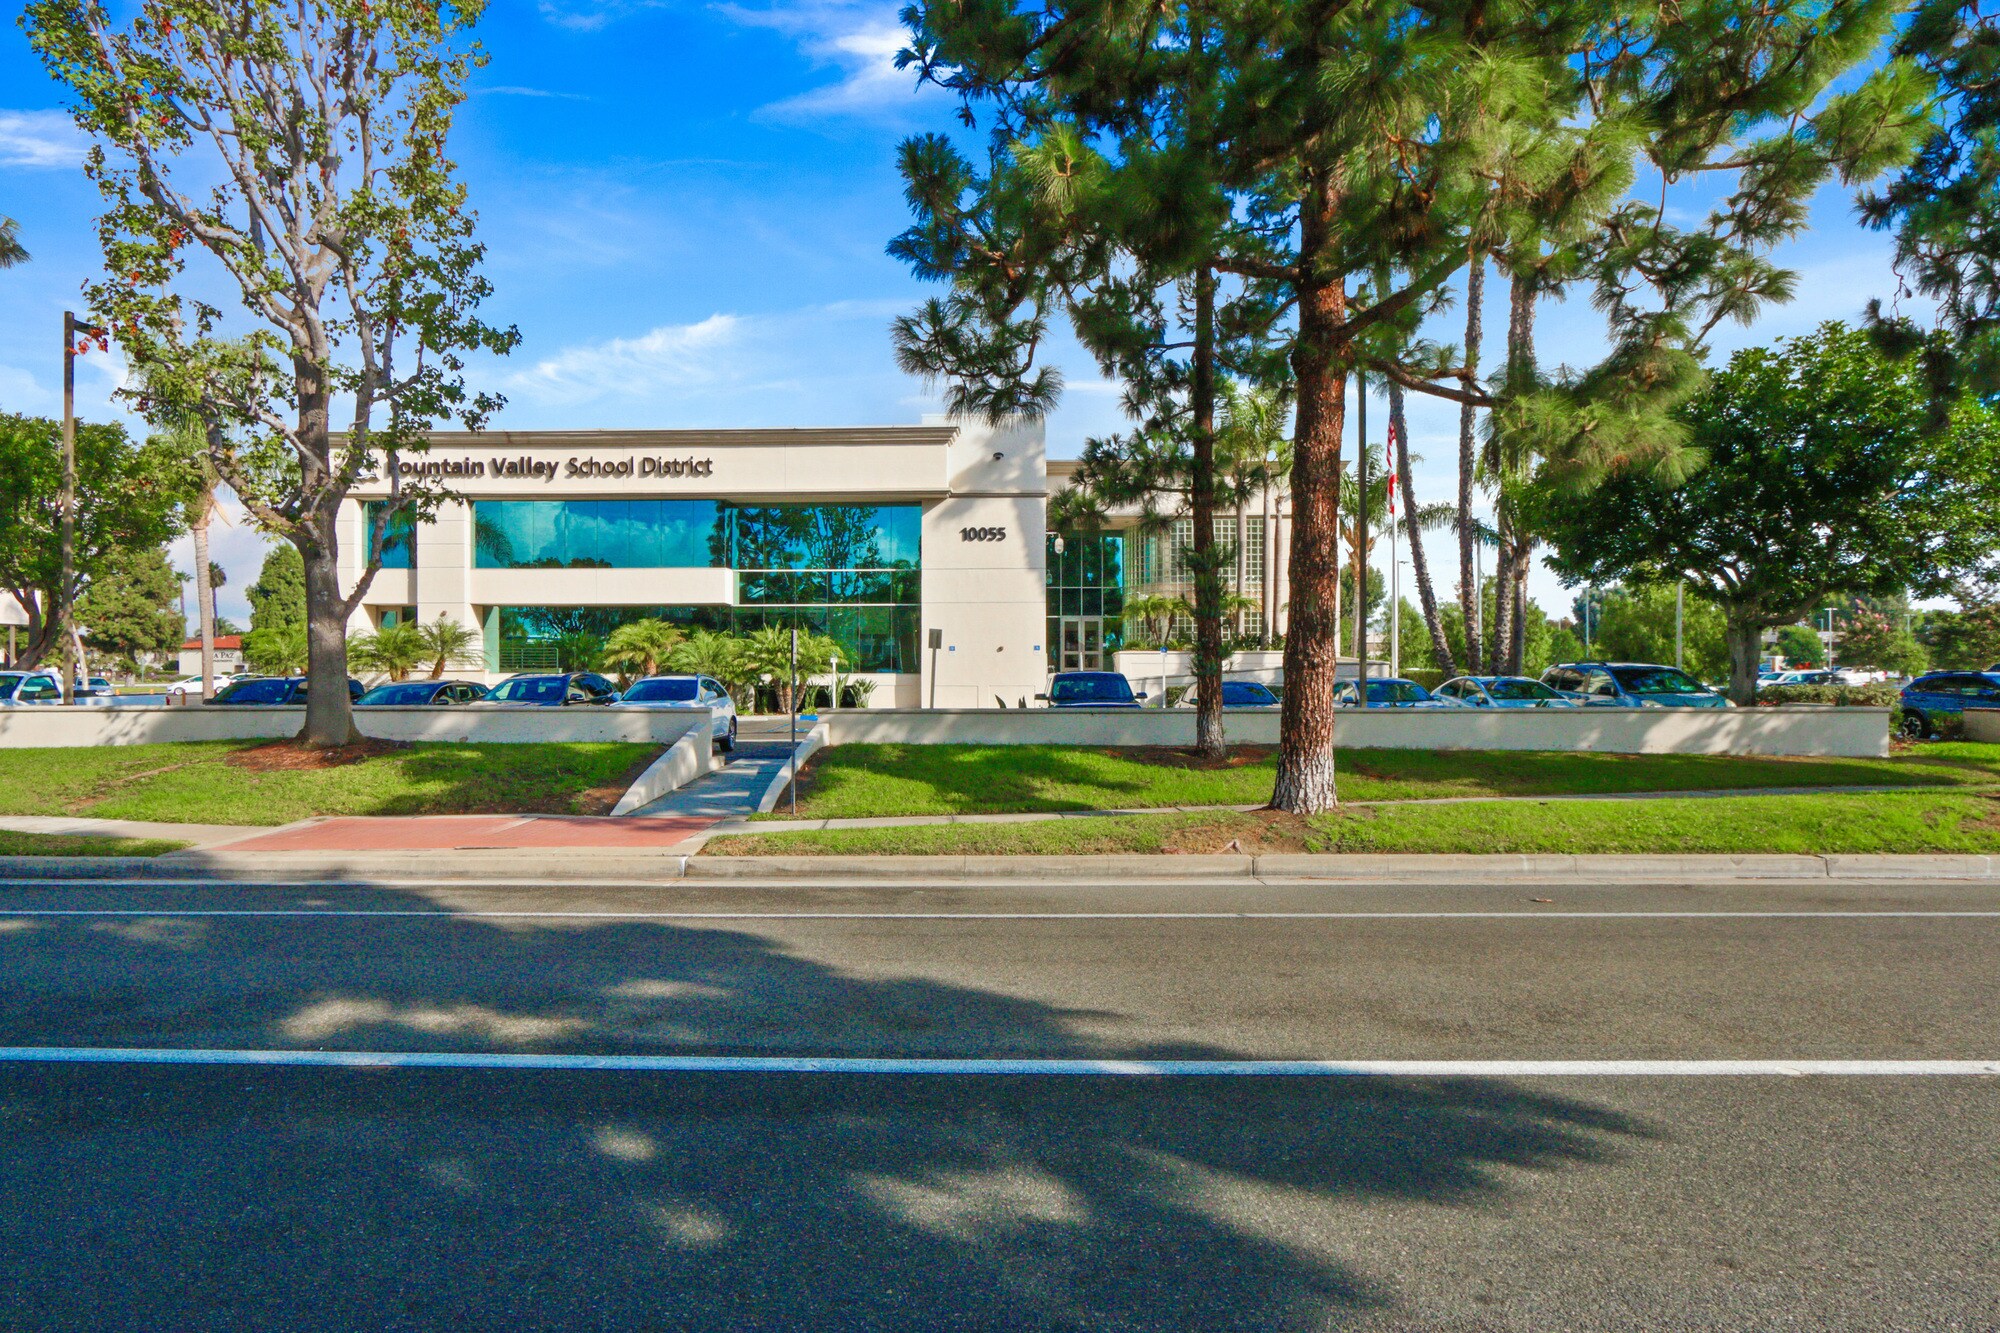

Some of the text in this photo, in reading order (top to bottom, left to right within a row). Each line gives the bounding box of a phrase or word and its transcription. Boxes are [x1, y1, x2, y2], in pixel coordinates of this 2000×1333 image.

[492, 457, 560, 479] Valley
[568, 456, 635, 475] School
[642, 456, 714, 475] District
[959, 526, 1007, 542] 10055
[220, 651, 235, 659] PAZ
